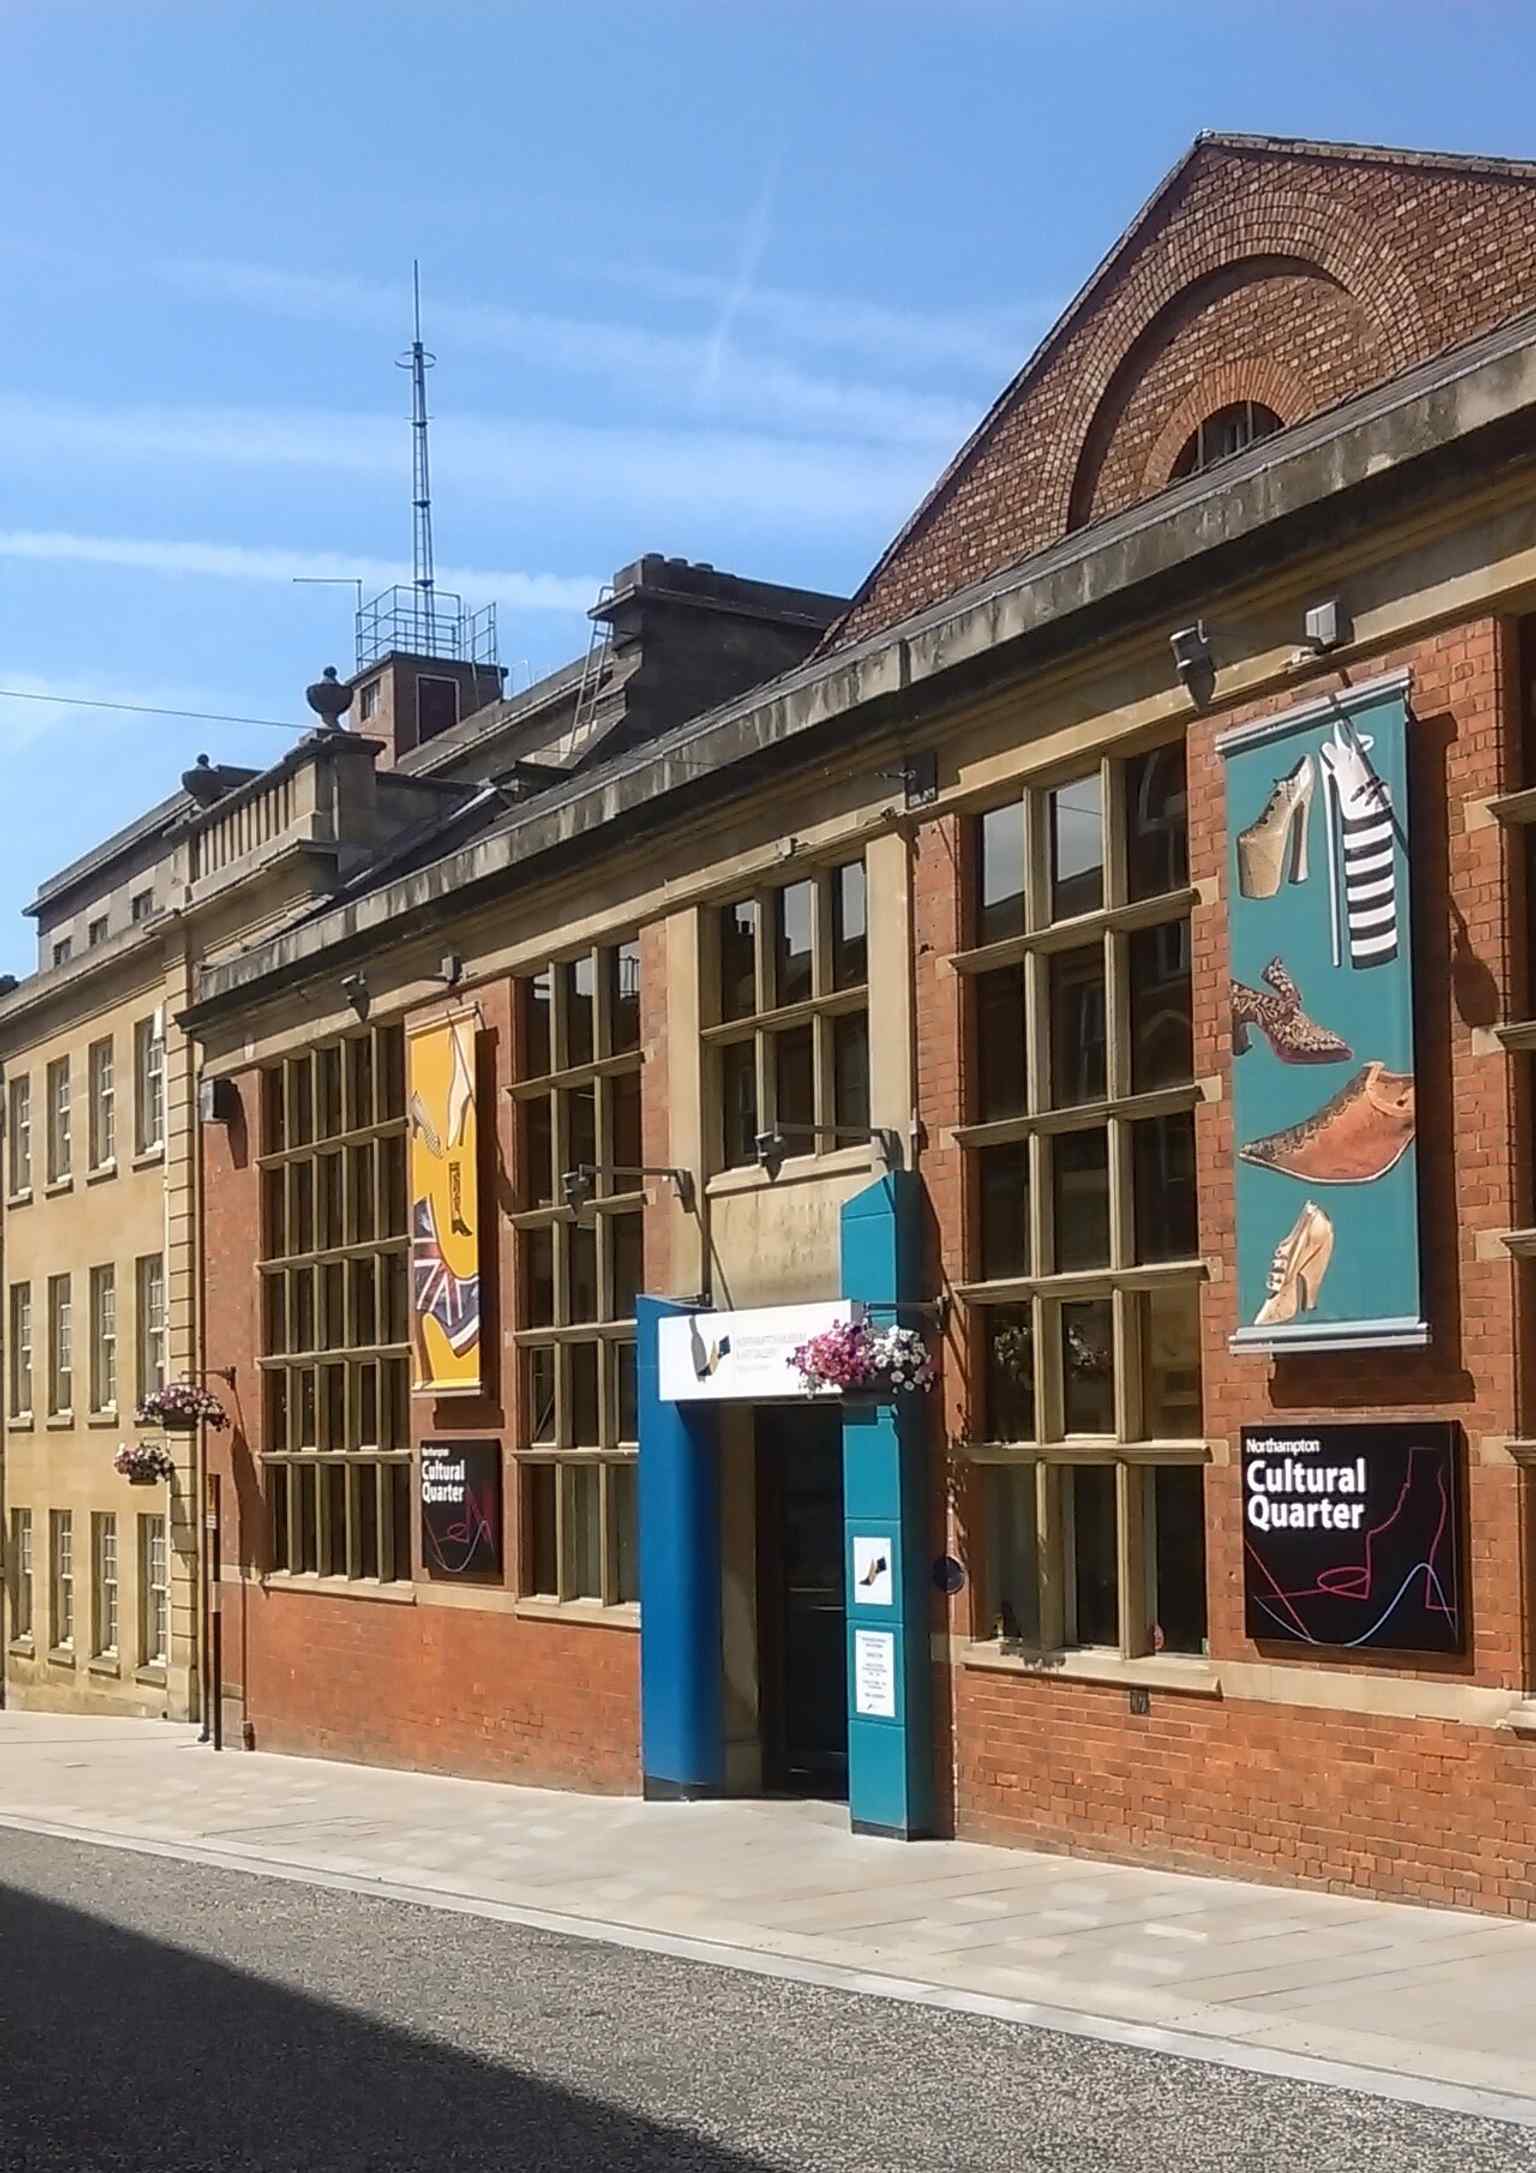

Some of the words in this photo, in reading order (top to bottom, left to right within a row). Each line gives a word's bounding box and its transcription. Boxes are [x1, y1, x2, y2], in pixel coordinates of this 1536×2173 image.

[1246, 1438, 1320, 1455] Northampton
[422, 1459, 465, 1480] Cultural
[1246, 1457, 1366, 1493] Cultural
[422, 1481, 465, 1504] Quarter
[1247, 1494, 1365, 1531] Quarter
